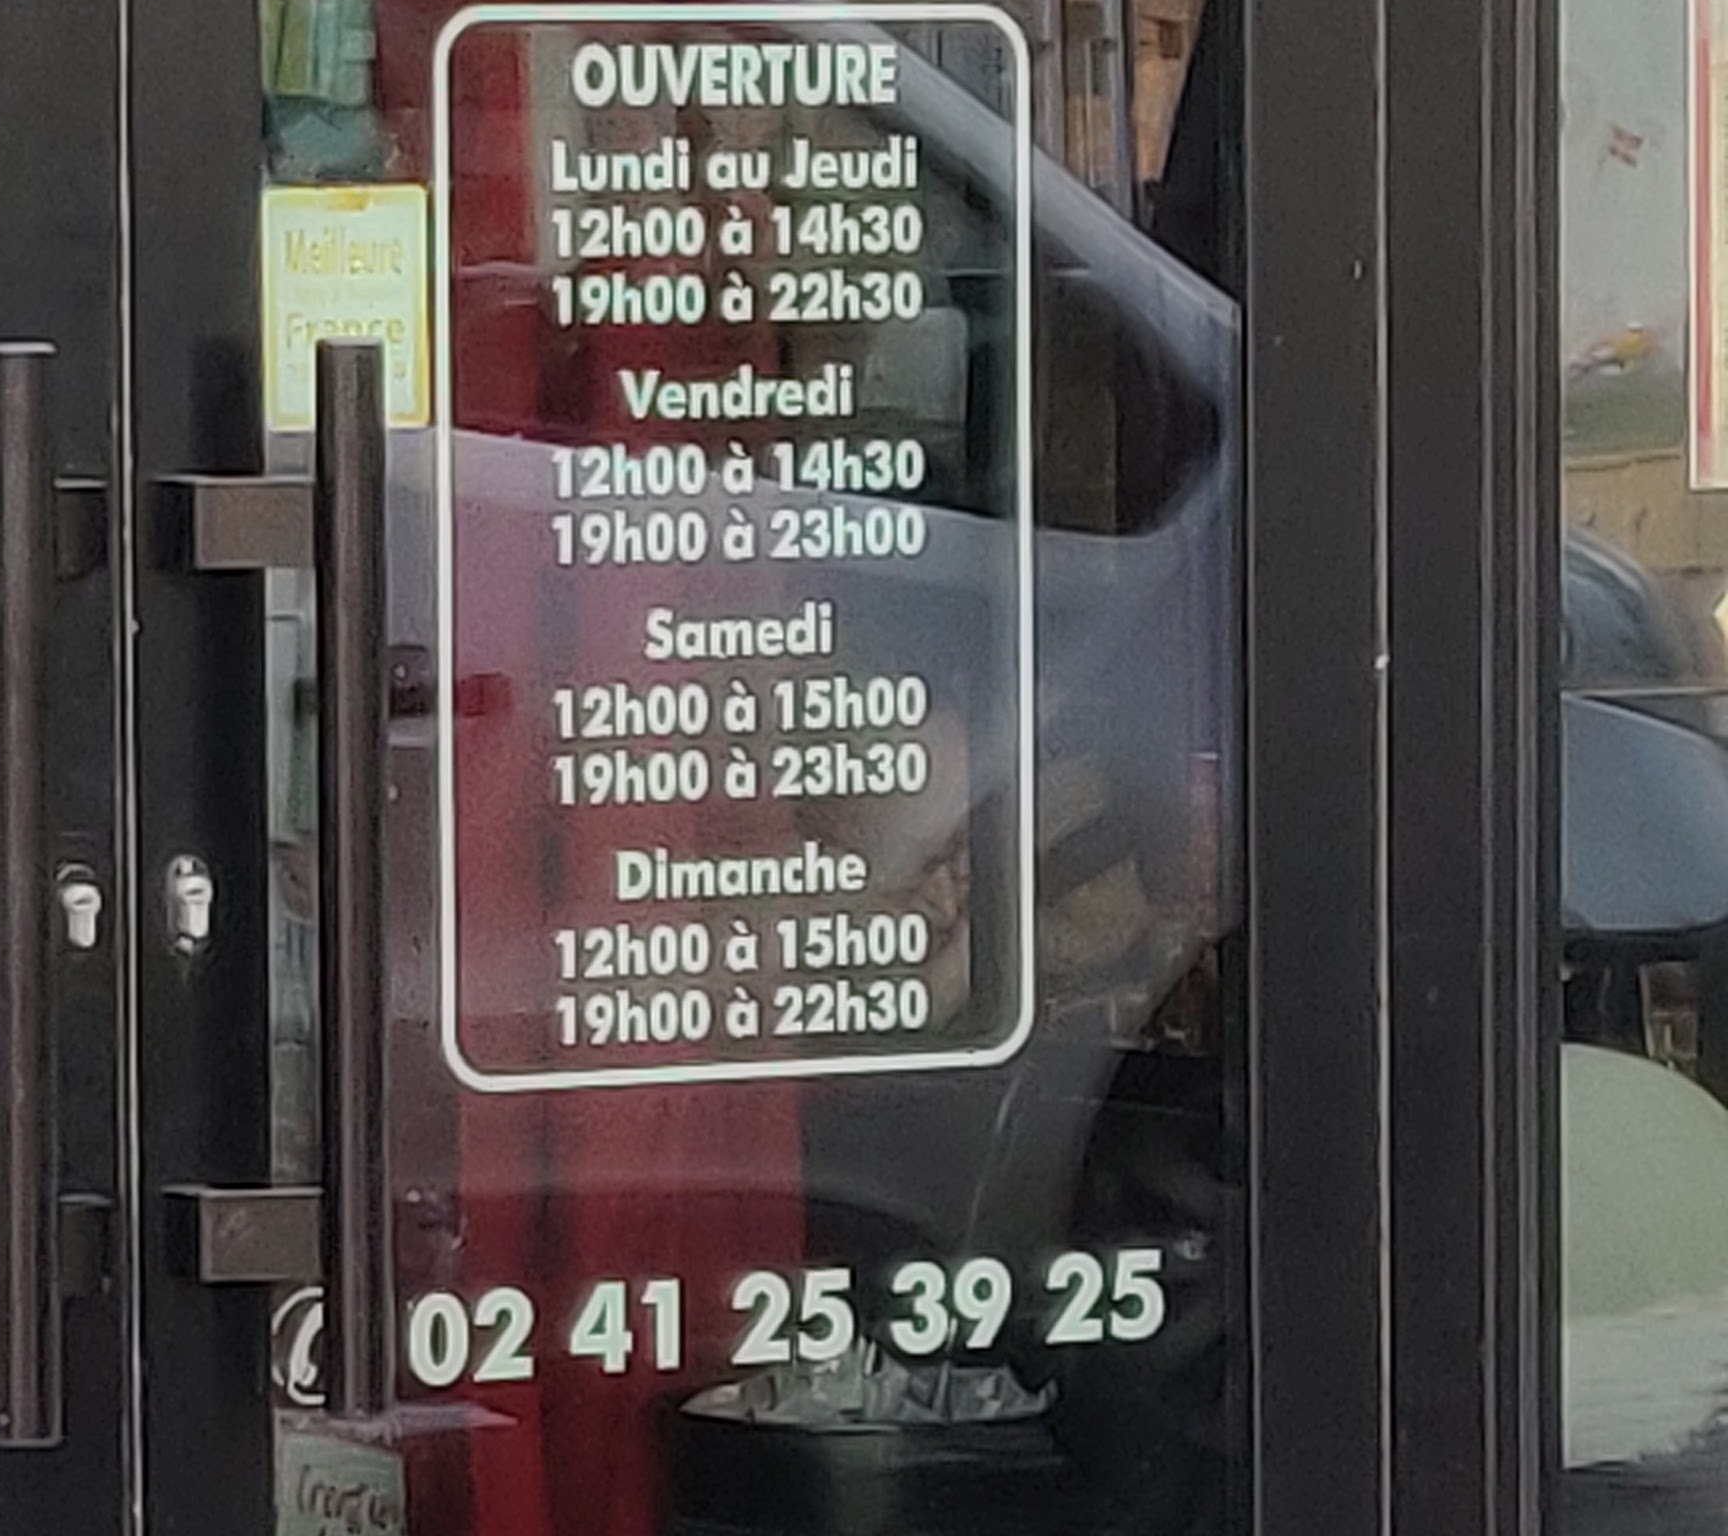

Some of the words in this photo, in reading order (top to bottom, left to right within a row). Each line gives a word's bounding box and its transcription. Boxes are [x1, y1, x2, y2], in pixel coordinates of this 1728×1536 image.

[571, 41, 899, 108] OUVERTURE
[551, 135, 691, 192] Lundi
[705, 155, 770, 190] au
[783, 135, 919, 189] Jeudi
[551, 207, 705, 259] 12h00
[719, 206, 754, 256] à
[772, 205, 924, 256] 14h30
[551, 273, 706, 326] 19h00
[719, 273, 754, 323] à
[770, 271, 924, 323] 22h30
[617, 364, 855, 420] Vendredi
[552, 444, 707, 499] 12h00
[722, 441, 756, 493] à
[773, 439, 926, 491] 14h30
[552, 510, 708, 566] 19h00
[722, 509, 756, 561] à
[770, 507, 927, 558] 23h00
[643, 600, 837, 659] Samedi
[553, 683, 709, 739] 12h00
[724, 680, 757, 733] à
[773, 676, 928, 732] 15h00
[553, 750, 710, 806] 19h00
[724, 748, 758, 799] à
[771, 742, 928, 797] 23h30
[614, 840, 869, 901] Dimanche
[554, 923, 710, 980] 12h00
[725, 921, 758, 971] à
[775, 913, 929, 970] 15h00
[555, 990, 711, 1046] 19h00
[726, 988, 759, 1040] à
[773, 979, 929, 1037] 22h30
[408, 1286, 535, 1387] 02
[569, 1279, 682, 1374] 41
[731, 1268, 856, 1366] 25
[890, 1257, 1014, 1356] 39
[1044, 1248, 1167, 1346] 25
